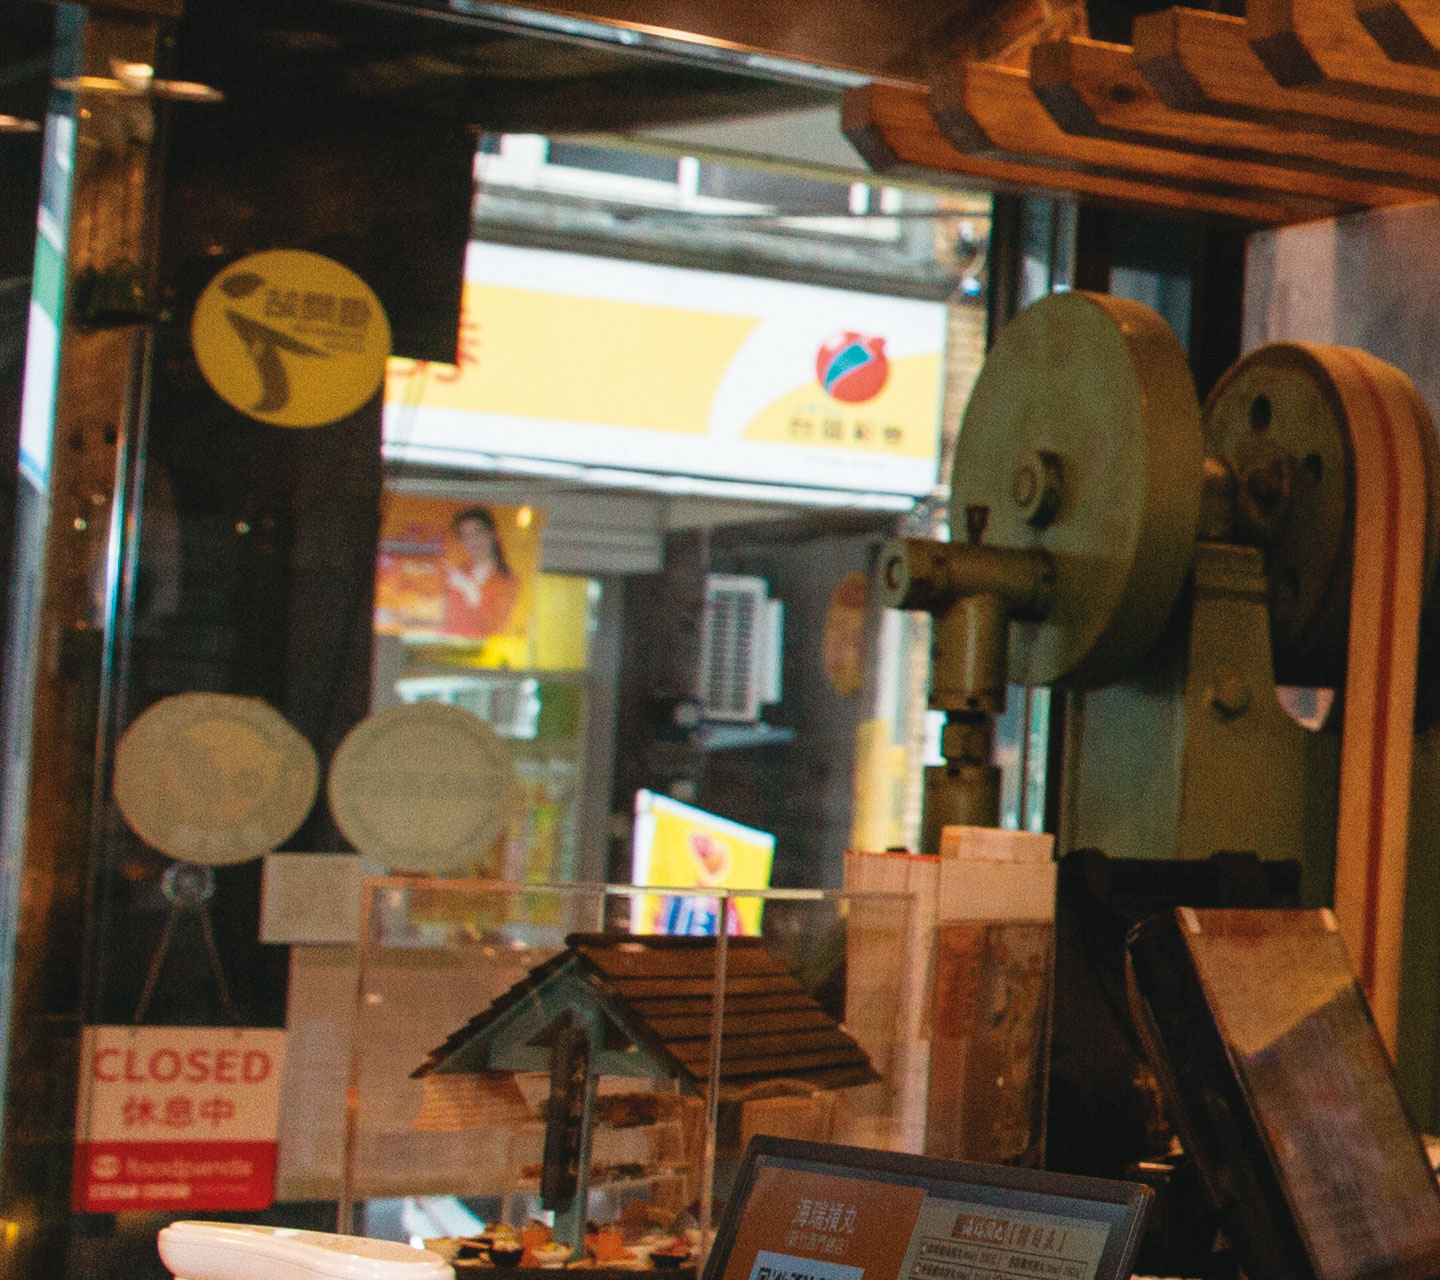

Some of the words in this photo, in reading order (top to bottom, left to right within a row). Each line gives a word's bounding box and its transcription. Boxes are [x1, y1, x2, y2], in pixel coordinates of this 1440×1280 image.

[92, 1048, 273, 1085] CLOSED
[122, 1095, 236, 1131] 休息中
